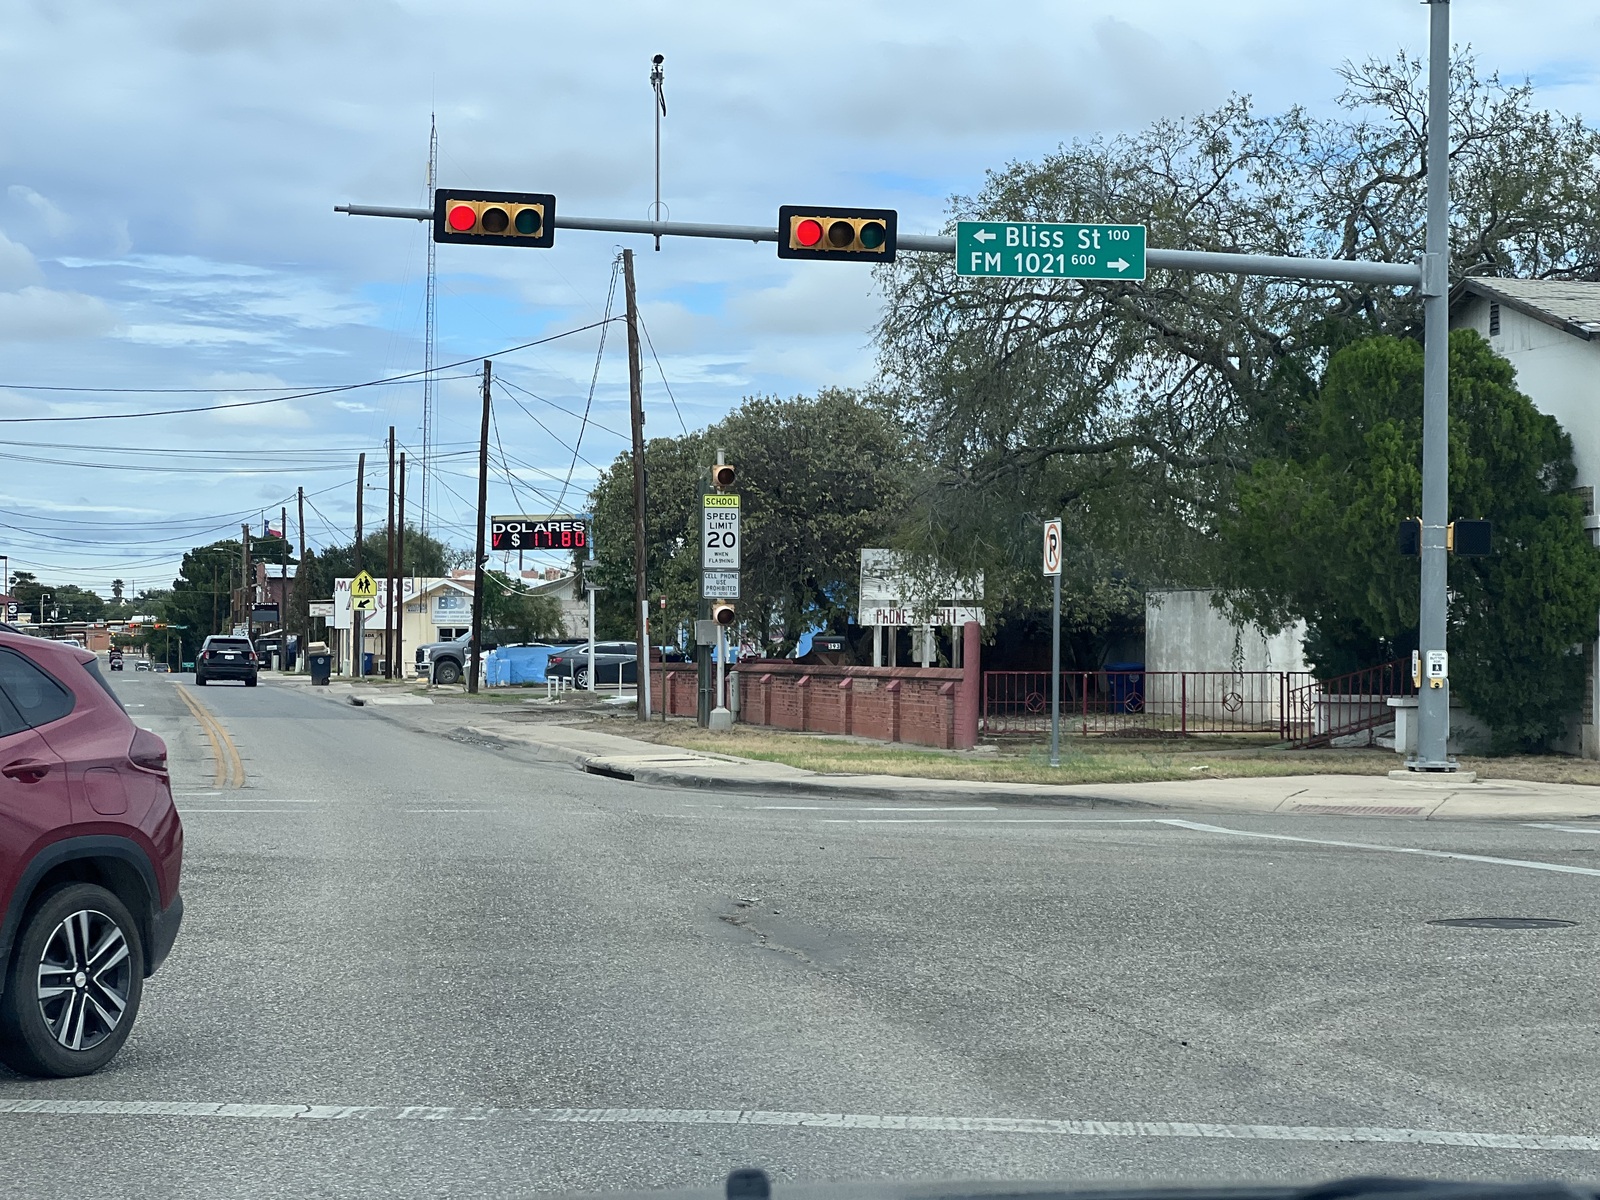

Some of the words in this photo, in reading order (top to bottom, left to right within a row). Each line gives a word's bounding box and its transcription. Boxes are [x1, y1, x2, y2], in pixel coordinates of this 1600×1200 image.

[1006, 225, 1064, 248] Bliss
[1078, 228, 1101, 249] St
[1107, 230, 1130, 241] 100
[971, 251, 1001, 272] FM
[1013, 252, 1065, 273] 1021
[1071, 254, 1096, 265] 600
[706, 497, 738, 506] SCHOOL
[706, 512, 737, 521] SPEED
[493, 521, 585, 533] DOLARES
[709, 522, 733, 530] LIMIT
[511, 532, 520, 547] $
[534, 531, 585, 547] 17.80
[707, 531, 736, 548] 20
